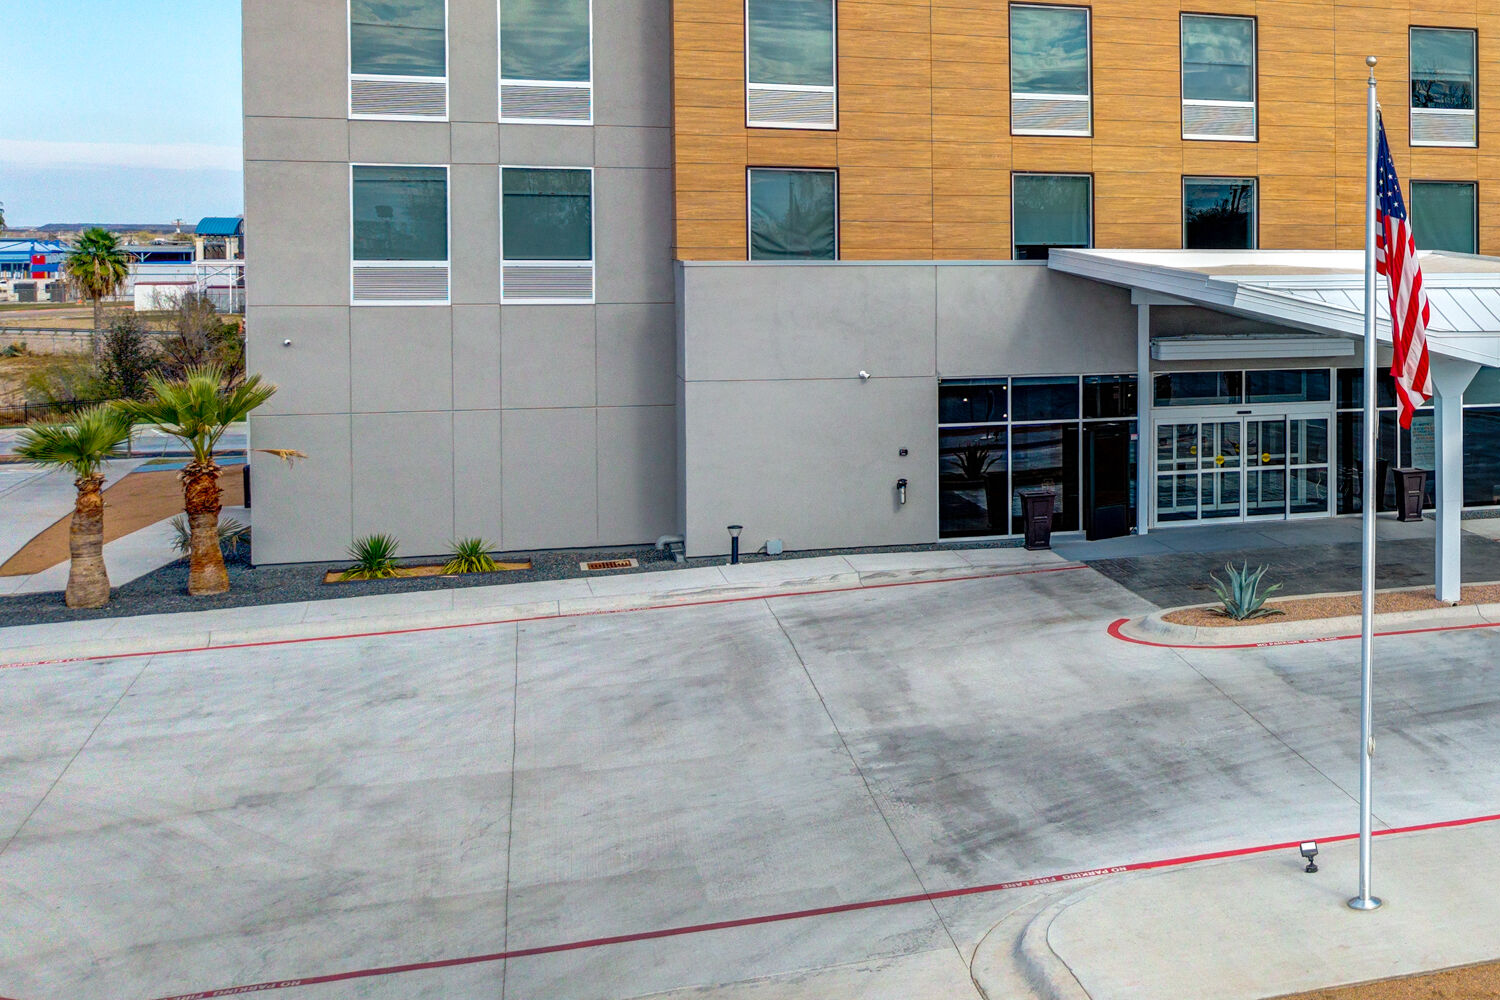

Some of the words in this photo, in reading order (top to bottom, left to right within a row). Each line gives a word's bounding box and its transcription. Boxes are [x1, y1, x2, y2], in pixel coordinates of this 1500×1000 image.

[1062, 869, 1109, 880] PARKING
[1001, 880, 1031, 889] LANE
[1034, 876, 1057, 885] FIRE
[213, 983, 276, 995] PARKING
